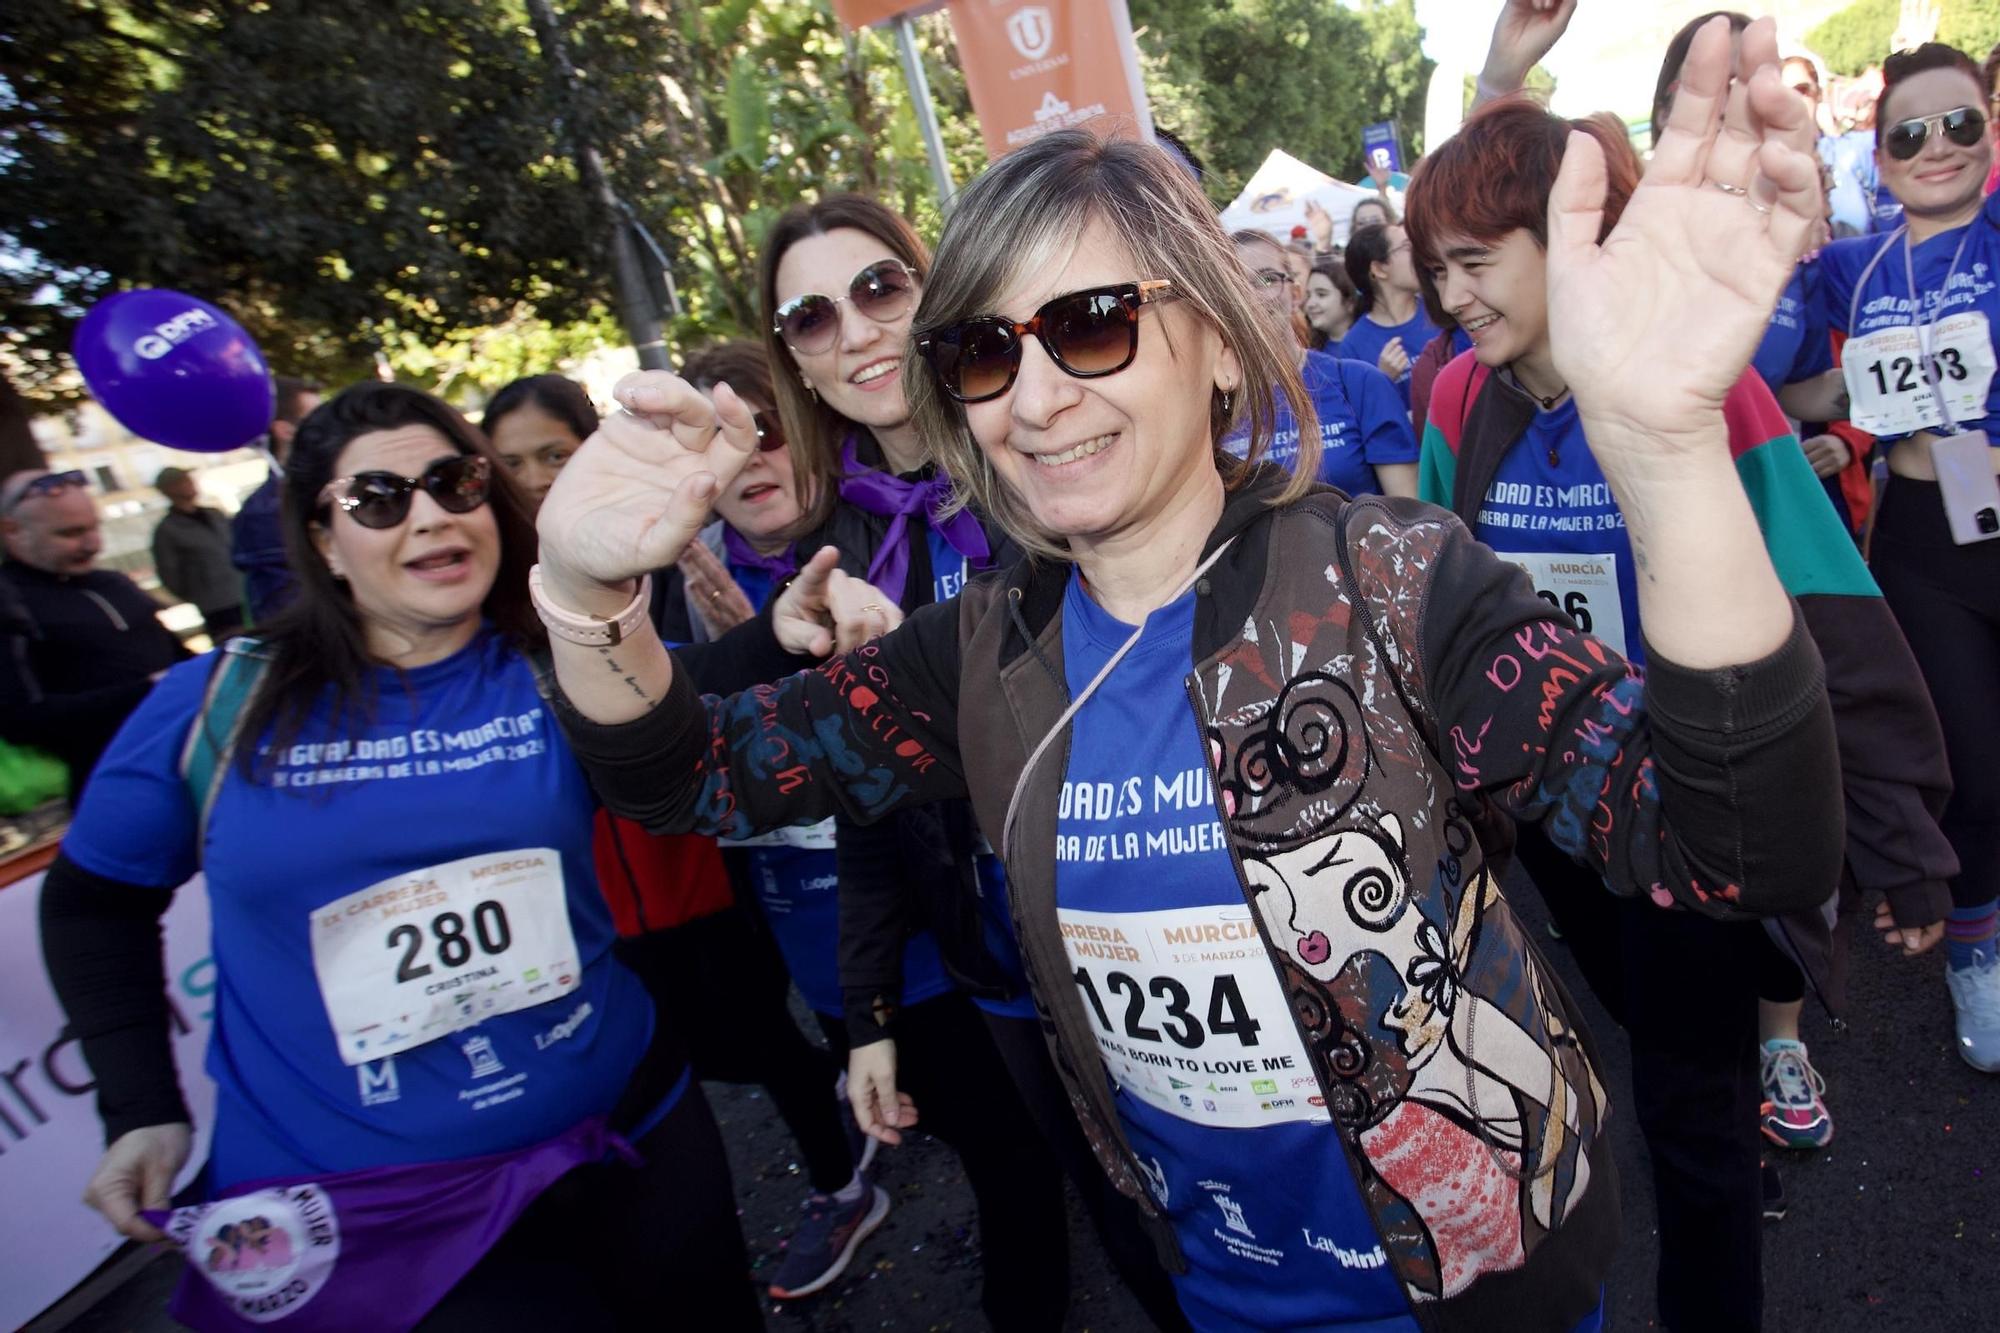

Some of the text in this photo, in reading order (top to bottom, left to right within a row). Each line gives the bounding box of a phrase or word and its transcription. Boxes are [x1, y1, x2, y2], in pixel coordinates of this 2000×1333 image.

[1535, 484, 1554, 508] ES
[1511, 513, 1529, 528] DE
[1530, 515, 1548, 530] LA
[1596, 511, 1626, 530] 202
[1550, 563, 1606, 576] MURCIA
[411, 729, 441, 754] ES
[387, 761, 413, 779] DE
[415, 757, 441, 776] LA
[443, 747, 505, 774] MUJER
[1058, 781, 1115, 821] DAD
[1056, 820, 1227, 863] RA DE LA MUJER
[346, 879, 440, 916] CARRERA
[470, 857, 546, 880] MURCIA
[382, 891, 448, 918] MUJER
[387, 899, 511, 985] 280
[1060, 922, 1128, 943] RRERA
[1073, 941, 1141, 963] MUJER
[1200, 949, 1246, 962] MARZO
[424, 966, 499, 997] CRISTINA
[1073, 966, 1262, 1050] 1234
[1128, 1048, 1172, 1068] BORN
[1175, 1057, 1199, 1072] TO
[1203, 1058, 1258, 1075] LOVE
[1263, 1055, 1295, 1072] ME
[1271, 1099, 1295, 1108] DFM
